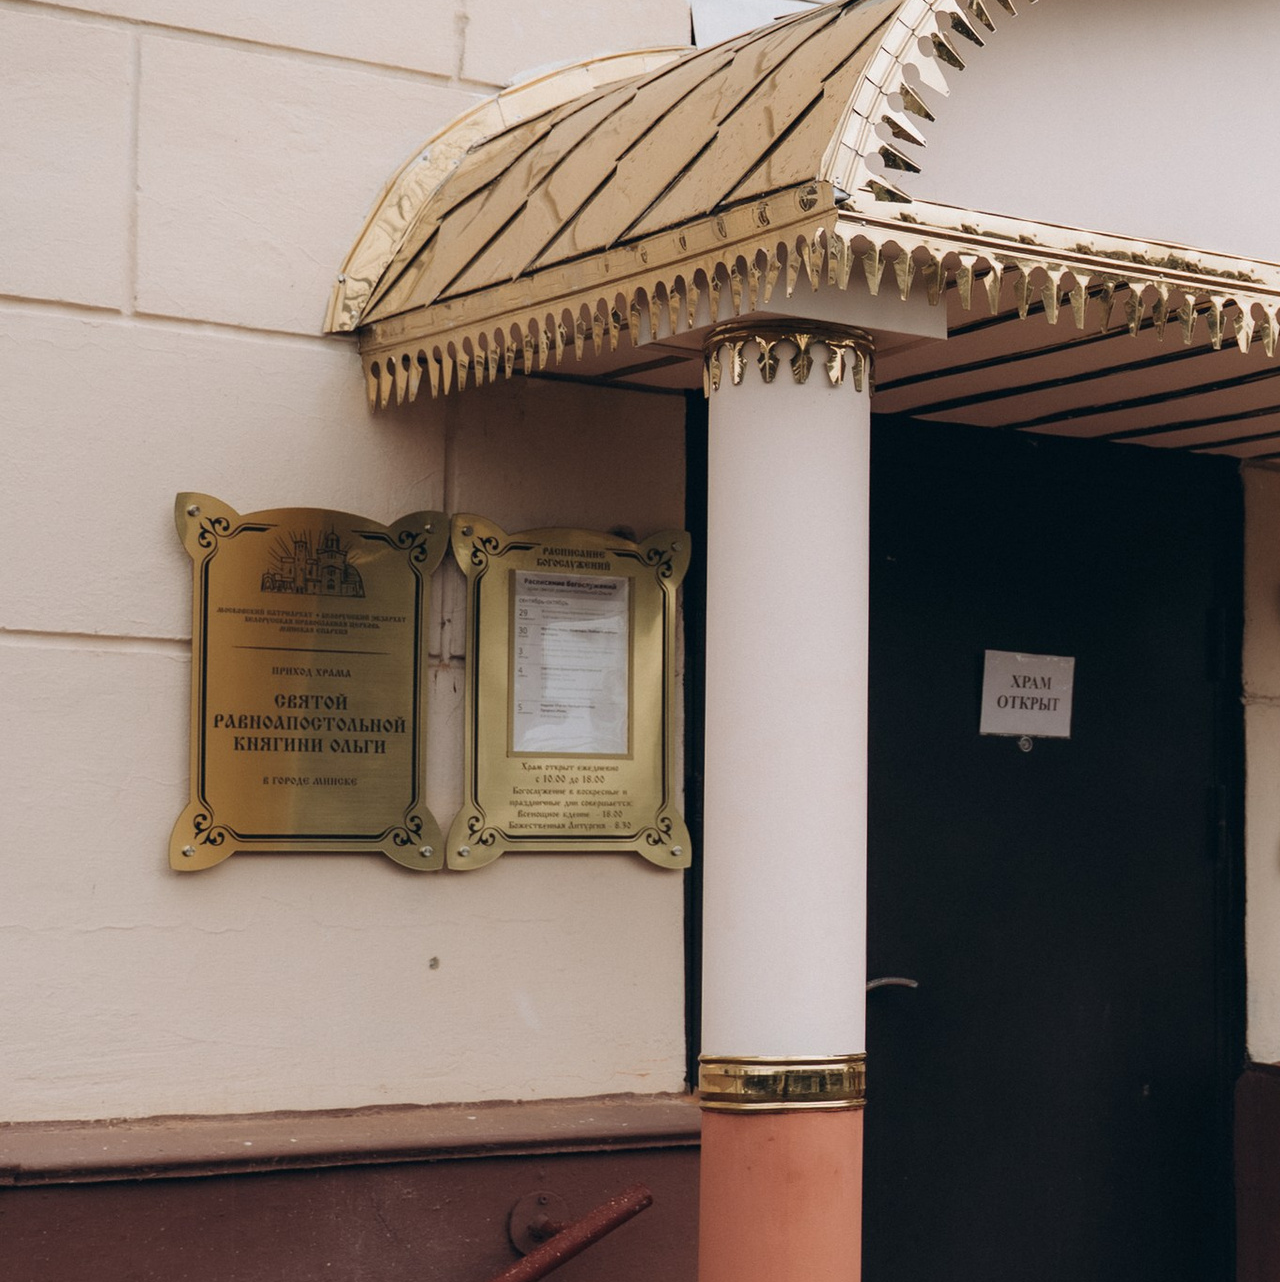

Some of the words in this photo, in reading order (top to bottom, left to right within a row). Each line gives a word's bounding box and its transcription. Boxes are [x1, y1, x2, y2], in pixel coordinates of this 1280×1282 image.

[543, 547, 605, 559] РАСПИСАНИЕ
[536, 558, 611, 571] БОГОСЛУЖЕНИЙ
[524, 578, 565, 587] Расписание
[566, 580, 617, 590] богослужений
[519, 608, 529, 617] 29
[518, 626, 528, 635] 30
[272, 666, 313, 678] ПРИХОД
[316, 668, 351, 678] ХРАМА
[1010, 674, 1052, 690] ХРАМ
[274, 693, 348, 710] СВЯТОЙ
[997, 694, 1060, 711] ОТКРЫТ
[213, 714, 406, 734] РАВНОАПОСТОЛЬНОЙ
[233, 736, 324, 753] КНЯГИНИ
[330, 738, 387, 754] ОЛЬГИ
[521, 762, 542, 772] Храм
[545, 764, 575, 772] открыт
[272, 776, 310, 786] ГОРОДЕ
[312, 777, 358, 786] МИНСКЕ
[543, 774, 566, 783] 10.00
[582, 775, 605, 783] 18.00
[512, 786, 566, 796] Богослужение
[602, 810, 623, 818] 18.00
